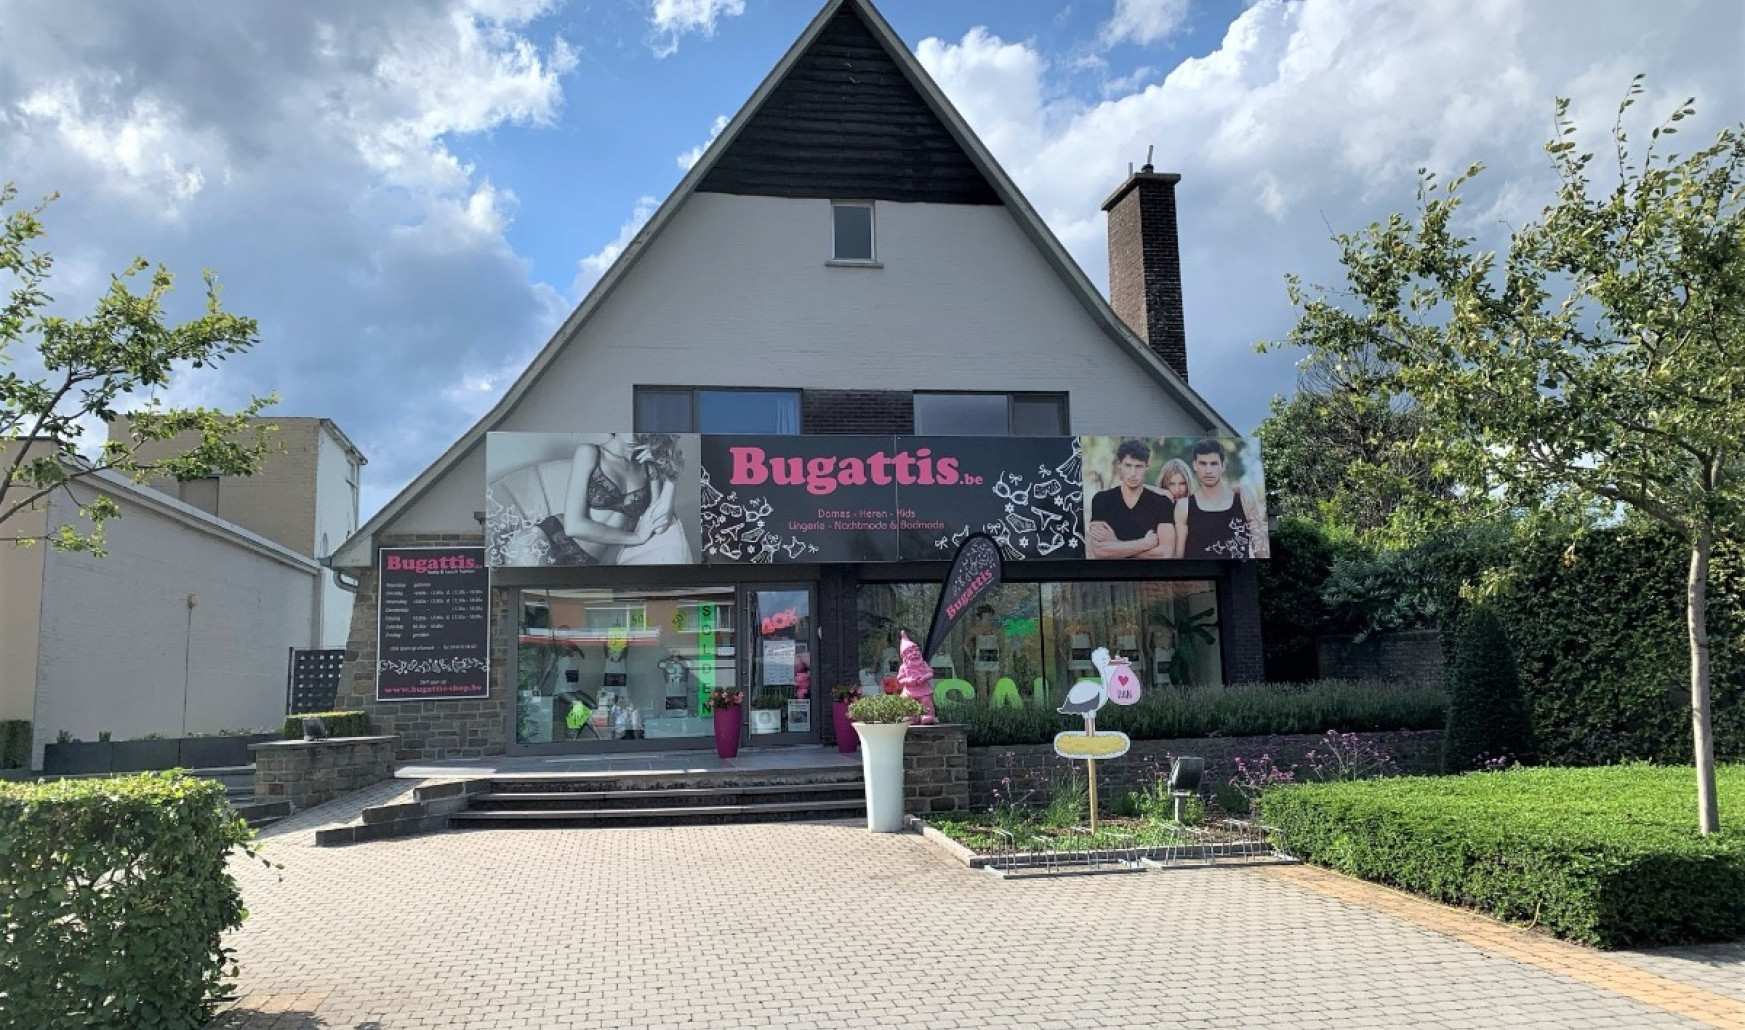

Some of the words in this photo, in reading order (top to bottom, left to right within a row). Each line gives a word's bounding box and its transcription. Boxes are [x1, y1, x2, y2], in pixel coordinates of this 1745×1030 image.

[788, 521, 825, 532] Lingerie
[859, 508, 888, 518] Heren
[896, 508, 916, 518] Kids
[946, 569, 993, 620] Bugattis
[702, 606, 712, 714] SOLDEN
